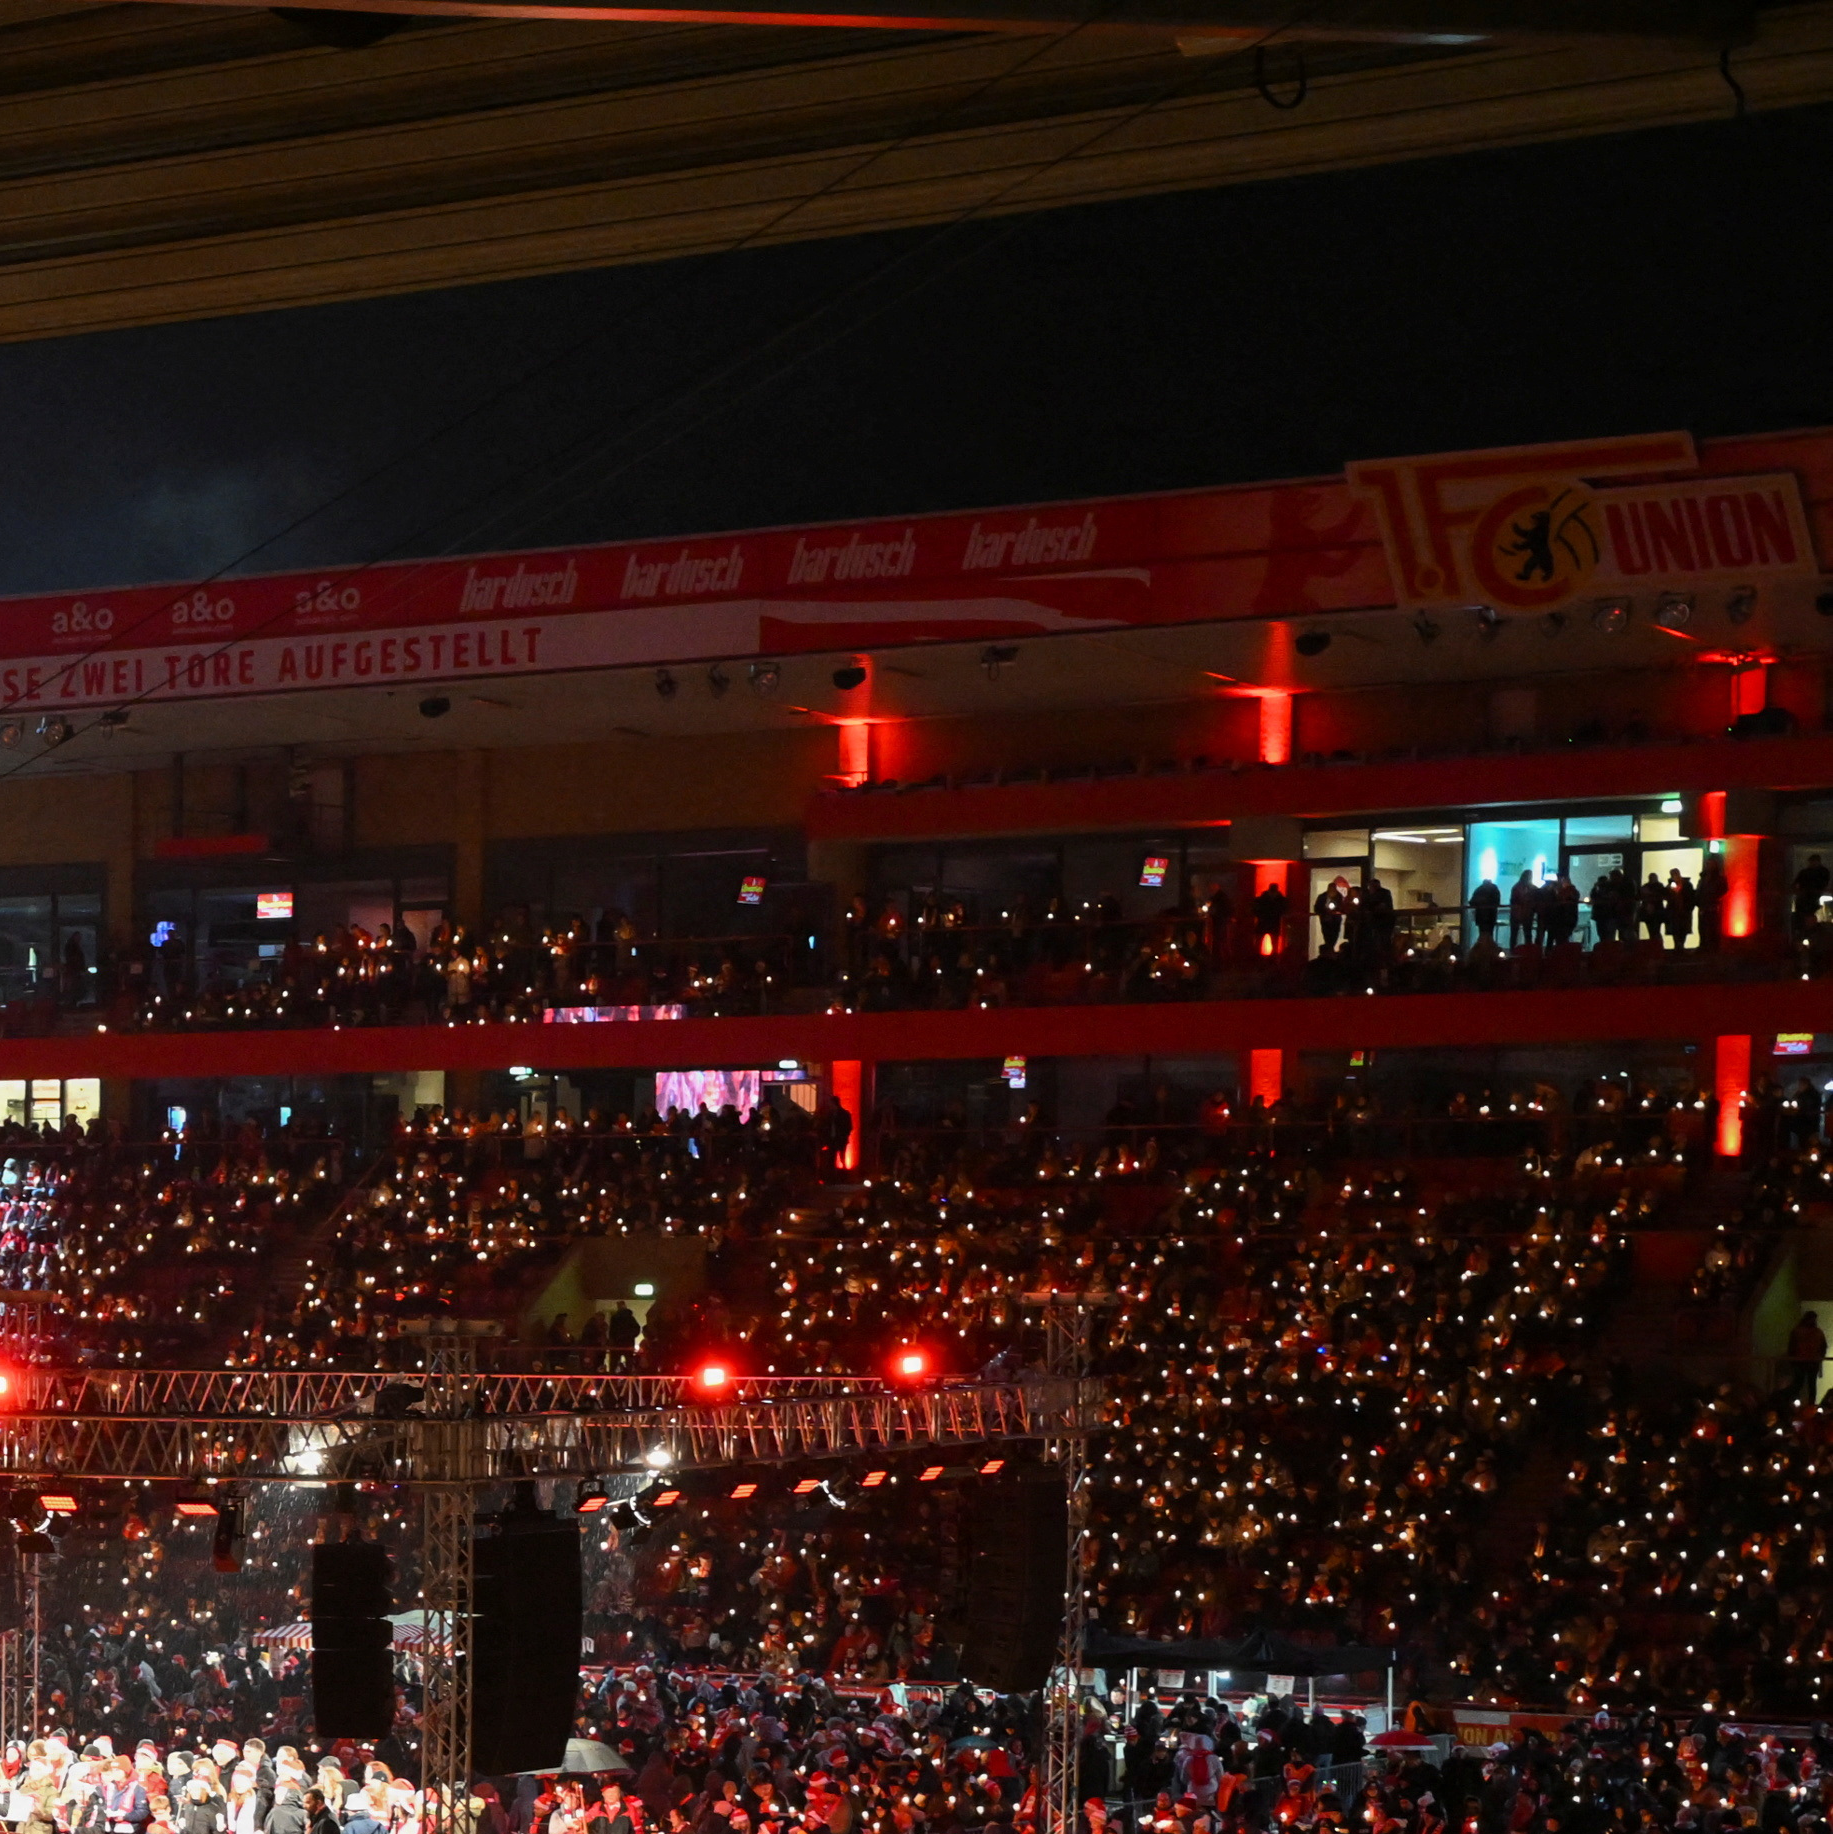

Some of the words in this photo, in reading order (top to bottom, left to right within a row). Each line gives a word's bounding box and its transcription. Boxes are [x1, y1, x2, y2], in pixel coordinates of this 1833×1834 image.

[1604, 489, 1797, 576] UNION
[171, 591, 234, 624] a&o
[294, 581, 361, 614] a&o
[51, 601, 114, 634] a&o
[60, 659, 143, 698] ZWEI
[164, 650, 255, 691] TORE
[278, 627, 542, 683] AUFGESTELLT
